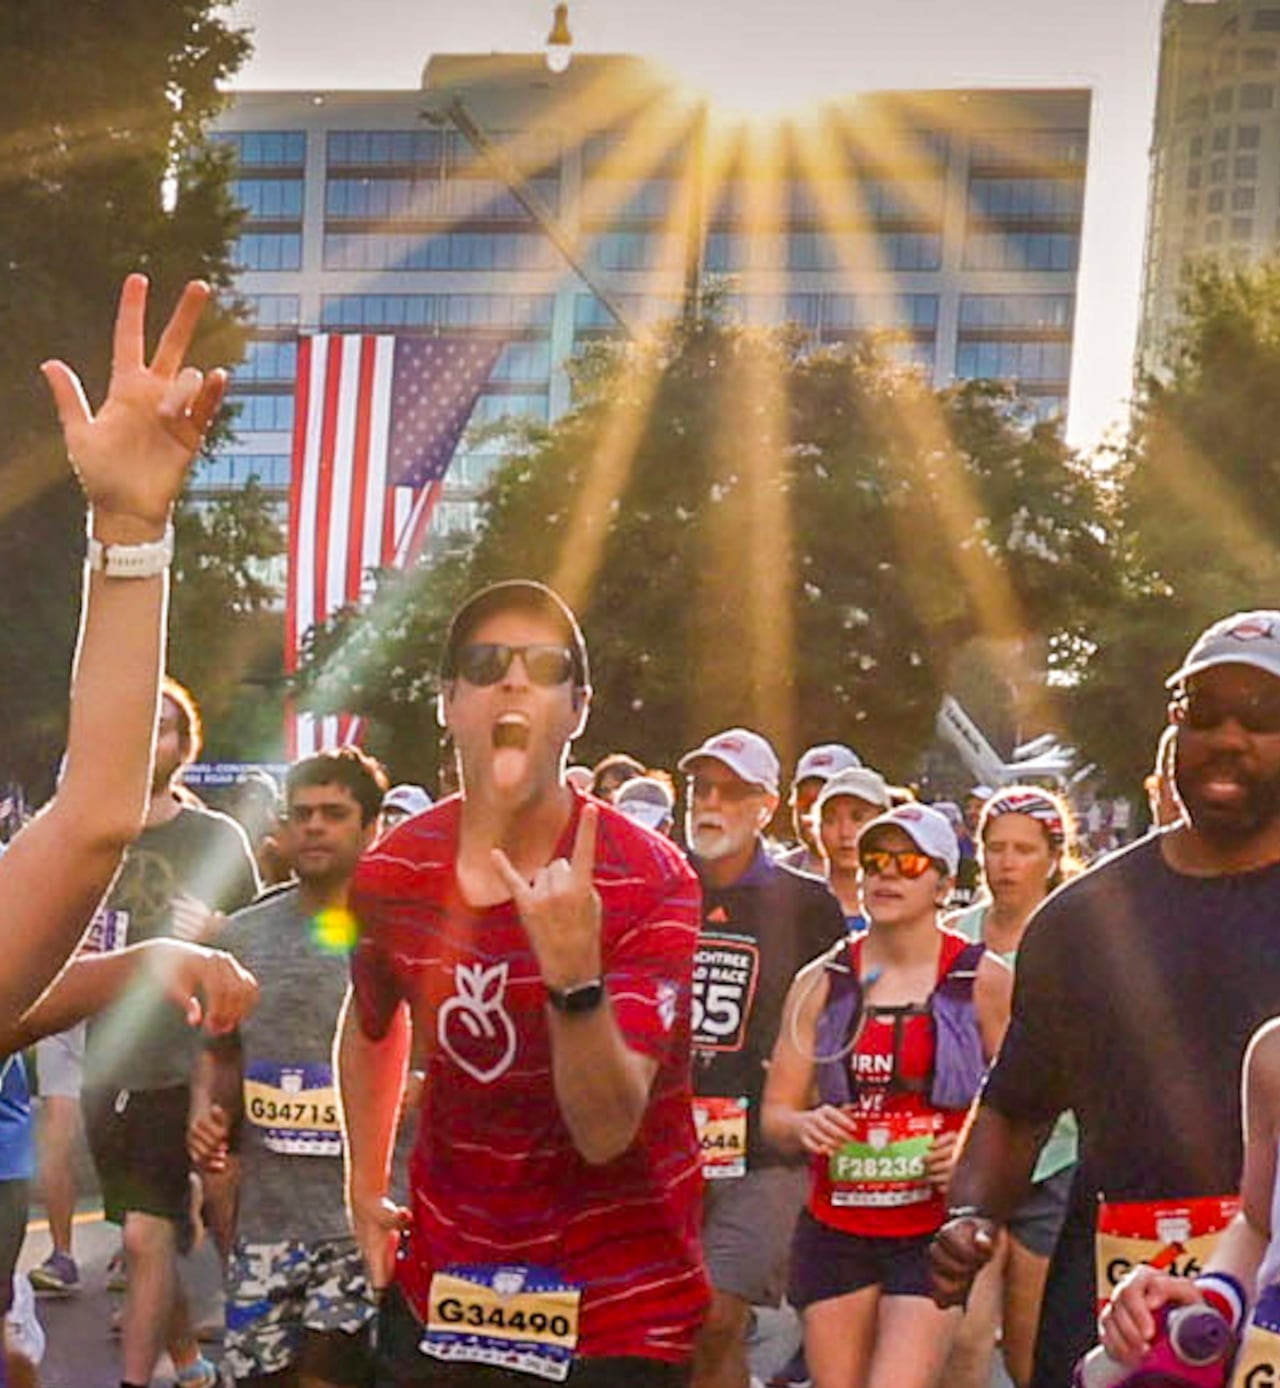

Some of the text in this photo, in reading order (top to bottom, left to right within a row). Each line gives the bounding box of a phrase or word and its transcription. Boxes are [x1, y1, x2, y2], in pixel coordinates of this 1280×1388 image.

[251, 1097, 337, 1124] G34715
[837, 1155, 925, 1178] F28236
[437, 1299, 569, 1337] G34490
